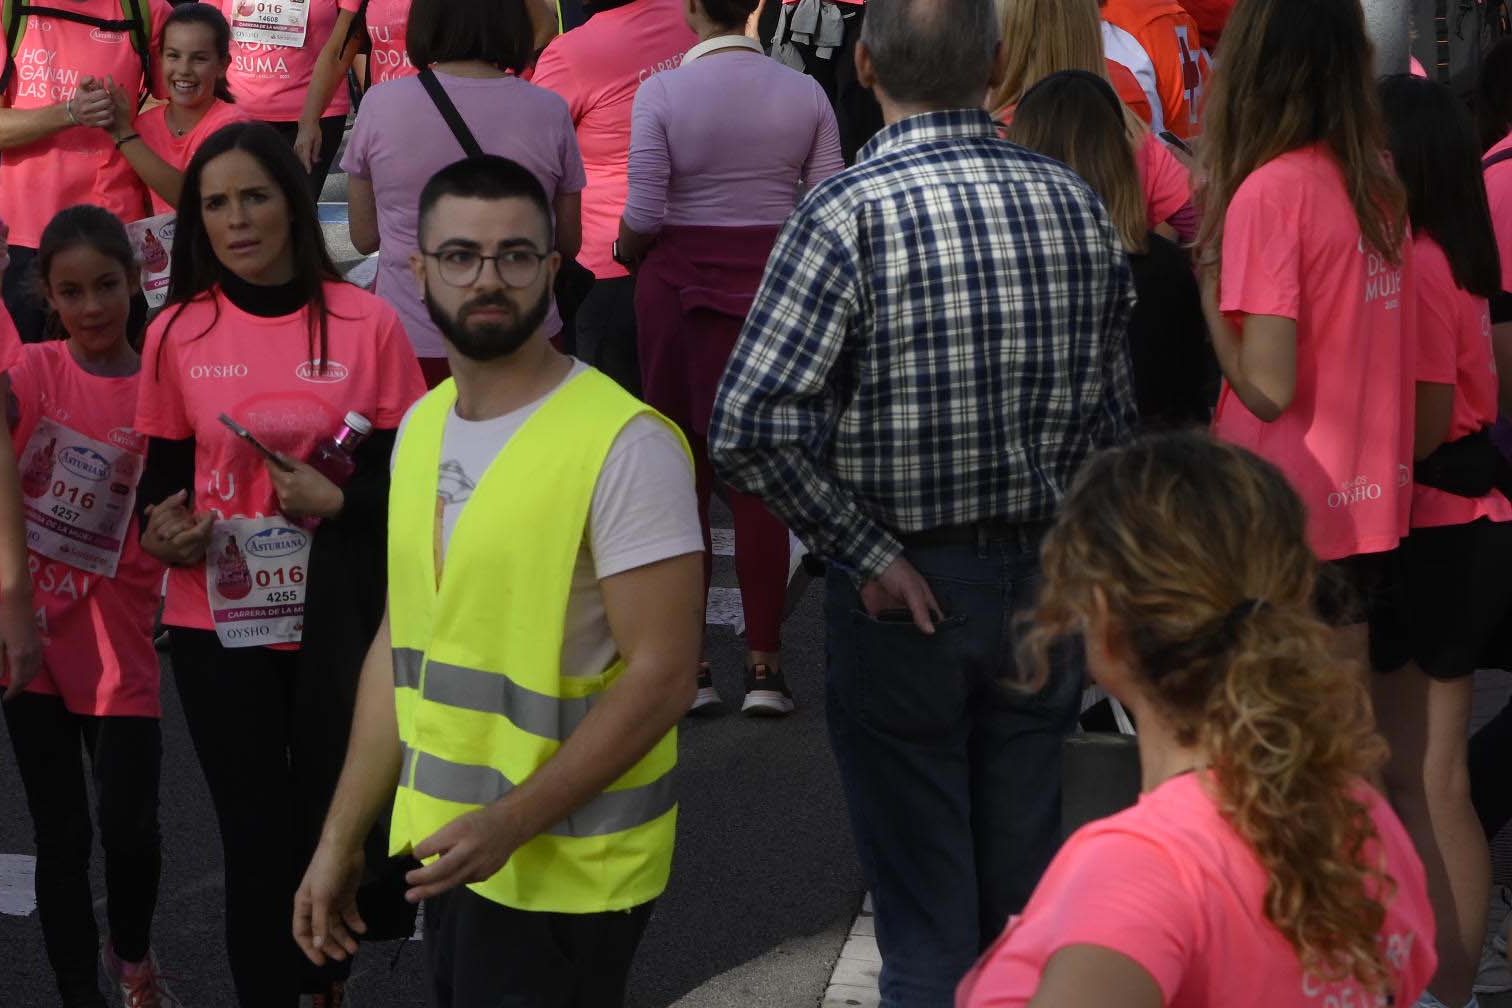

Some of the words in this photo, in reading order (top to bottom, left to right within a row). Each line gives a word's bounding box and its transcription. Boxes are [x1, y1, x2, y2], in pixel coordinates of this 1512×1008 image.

[257, 2, 282, 14] 016
[22, 48, 56, 65] HOY
[236, 55, 288, 72] SUMA
[20, 65, 79, 85] GANAN
[18, 82, 47, 98] LAS
[191, 364, 248, 379] OYSHO
[52, 480, 97, 510] 016
[1328, 483, 1381, 509] OYSHO
[51, 503, 80, 523] 4257
[250, 537, 304, 553] ASTURIANA
[256, 565, 304, 587] 016
[267, 591, 297, 603] 4255
[227, 609, 265, 619] CARRERA
[268, 608, 280, 617] DE
[281, 607, 292, 616] LA
[227, 626, 270, 640] OYSHO
